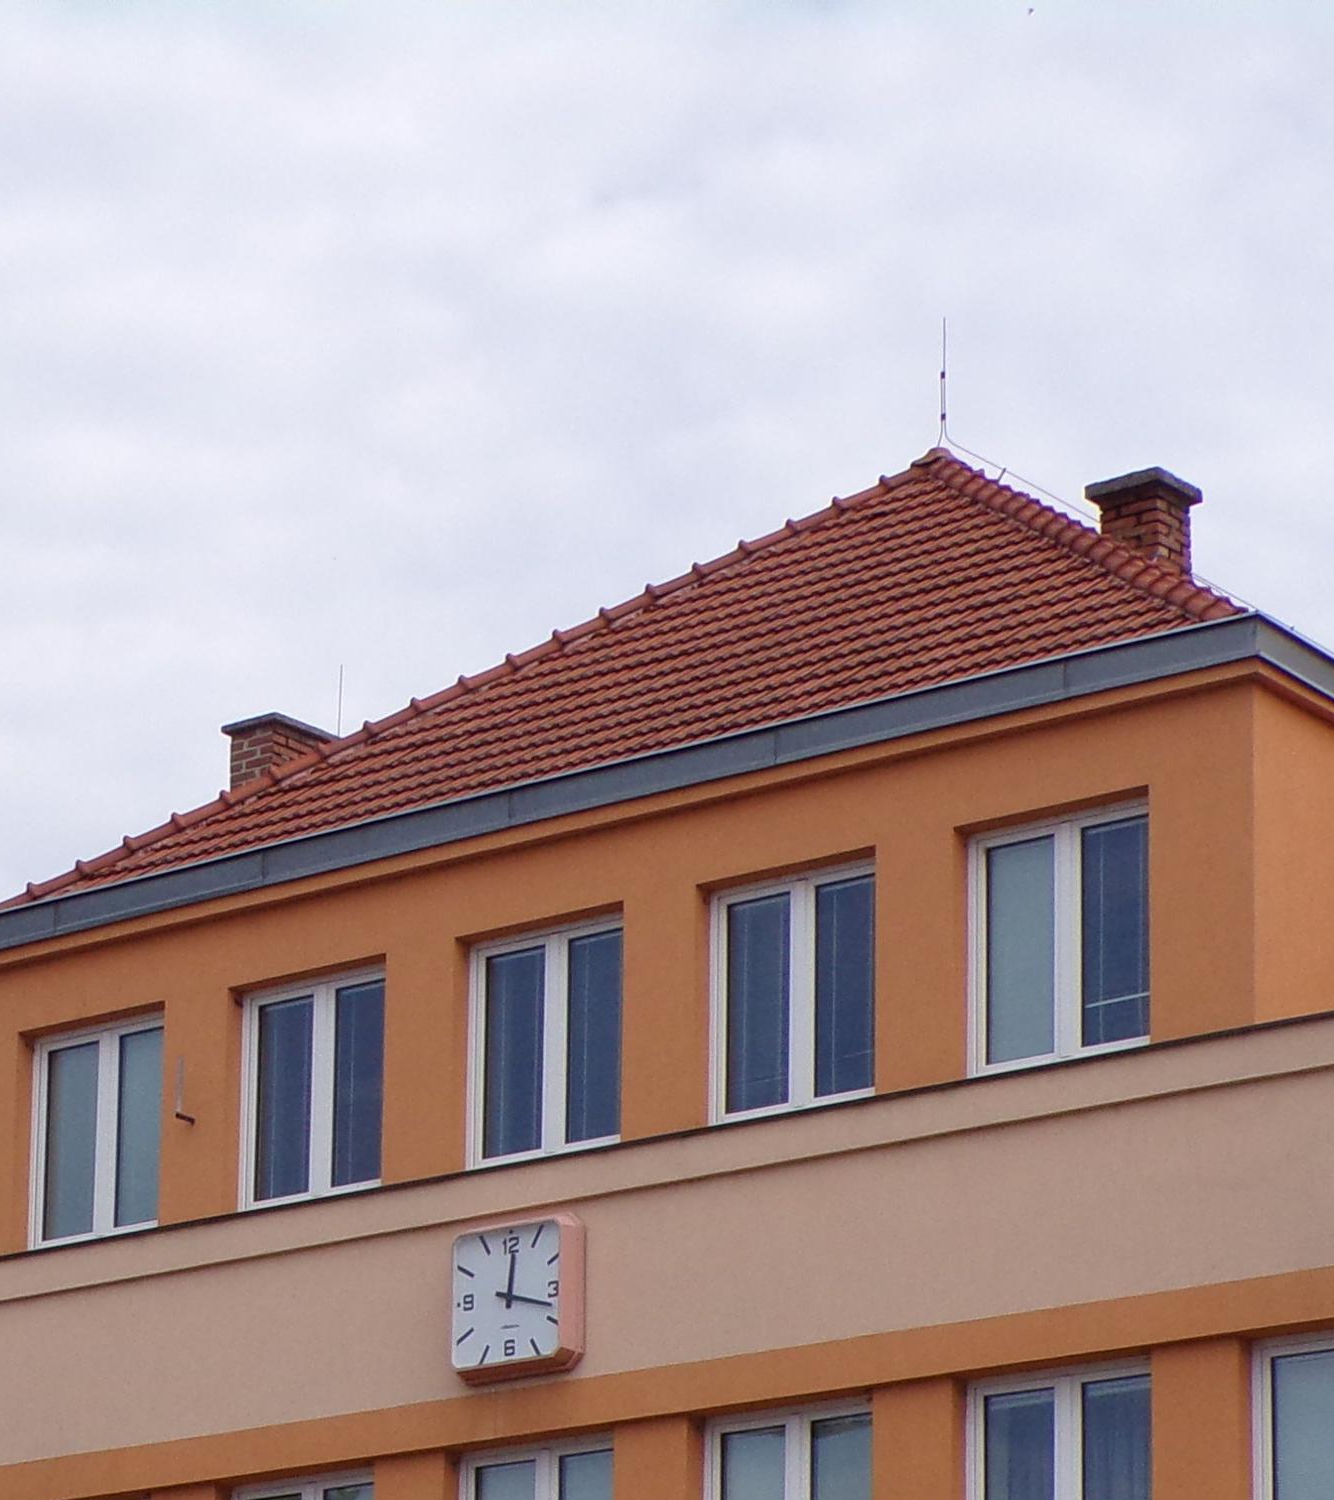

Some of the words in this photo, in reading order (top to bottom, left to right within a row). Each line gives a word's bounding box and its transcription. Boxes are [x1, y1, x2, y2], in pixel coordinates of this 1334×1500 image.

[502, 1236, 520, 1256] 12
[547, 1280, 560, 1299] 3
[462, 1293, 474, 1312] 9
[503, 1339, 516, 1357] 6
